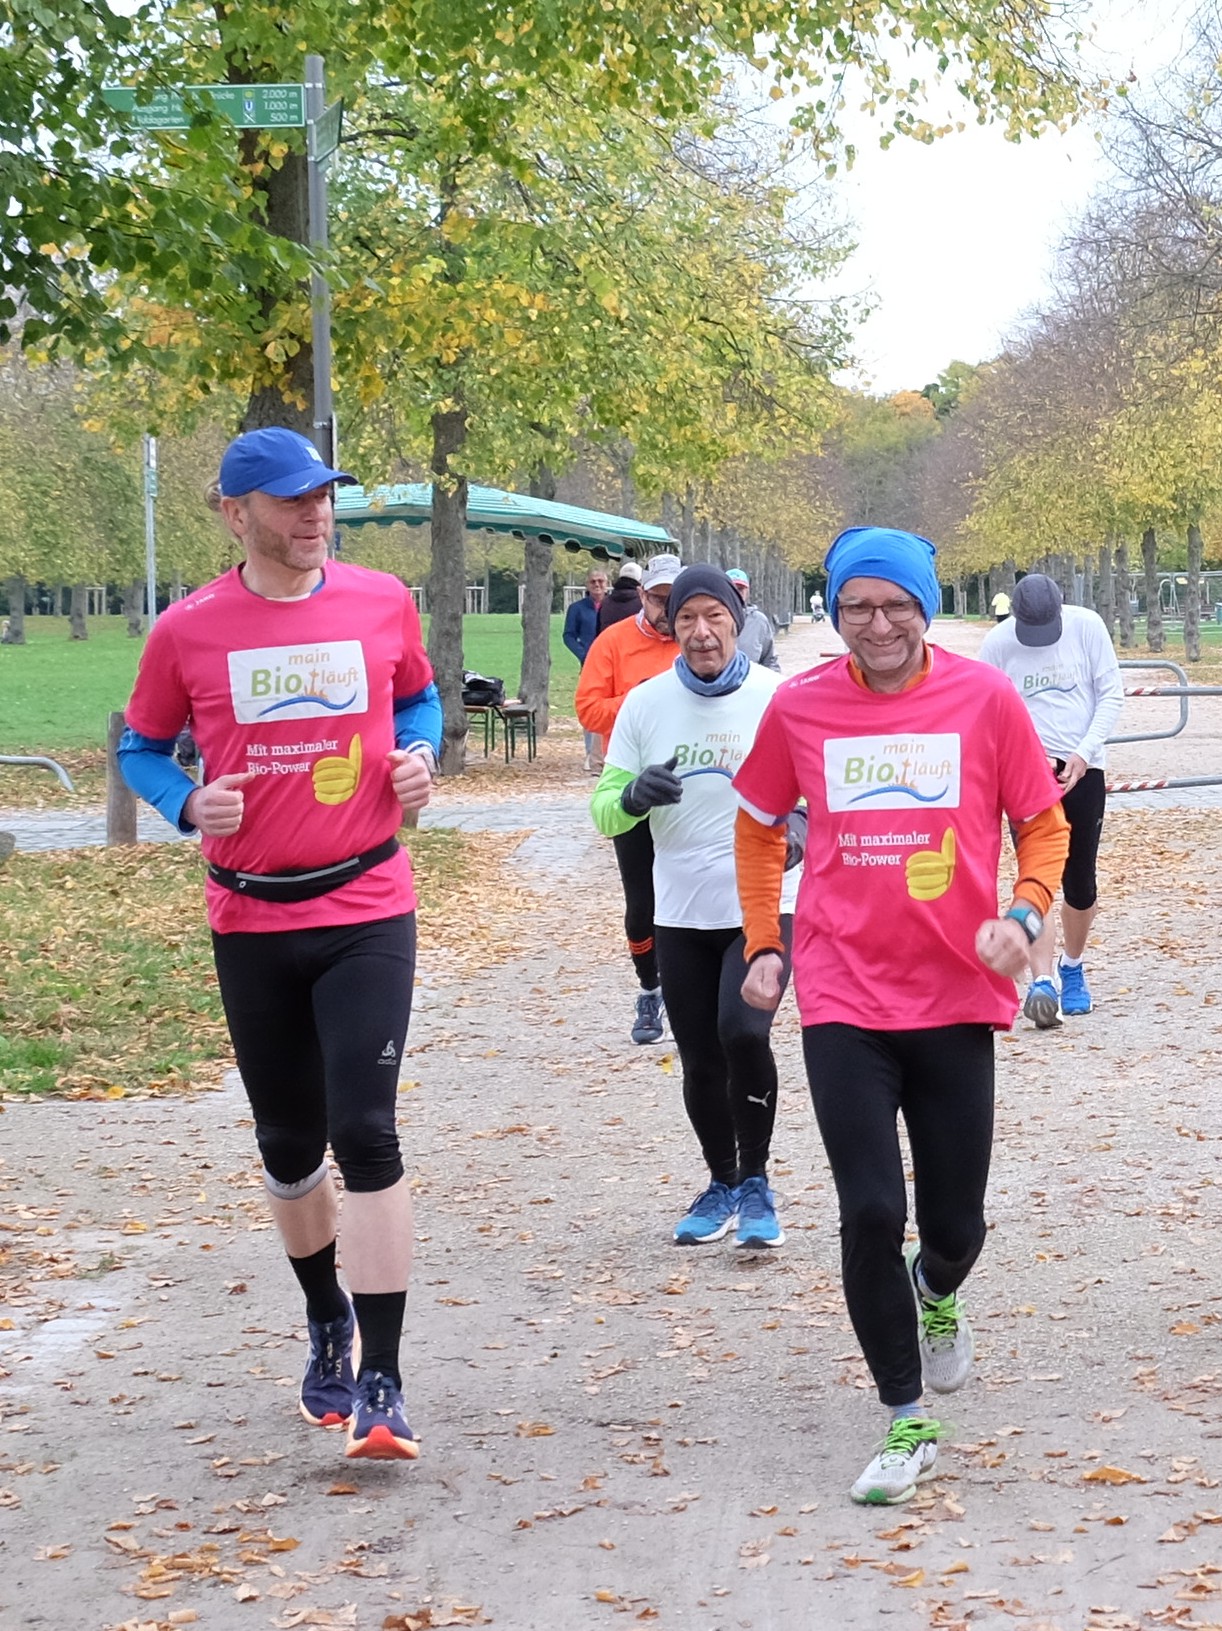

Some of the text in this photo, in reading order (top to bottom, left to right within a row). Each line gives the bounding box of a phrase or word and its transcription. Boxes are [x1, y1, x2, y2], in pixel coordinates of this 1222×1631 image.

[262, 89, 287, 99] 2.000
[264, 101, 287, 110] 1.000
[270, 112, 288, 122] 500
[288, 649, 330, 665] main
[251, 666, 359, 697] Bio läuft
[1023, 672, 1049, 690] Bio
[705, 730, 740, 742] main
[246, 739, 339, 757] Mit maximaler
[883, 739, 925, 754] main
[673, 743, 714, 767] Bio
[246, 761, 311, 775] Bio-Power
[844, 755, 895, 784] Bio
[860, 830, 931, 847] maximaler
[841, 852, 902, 866] Bio-Power
